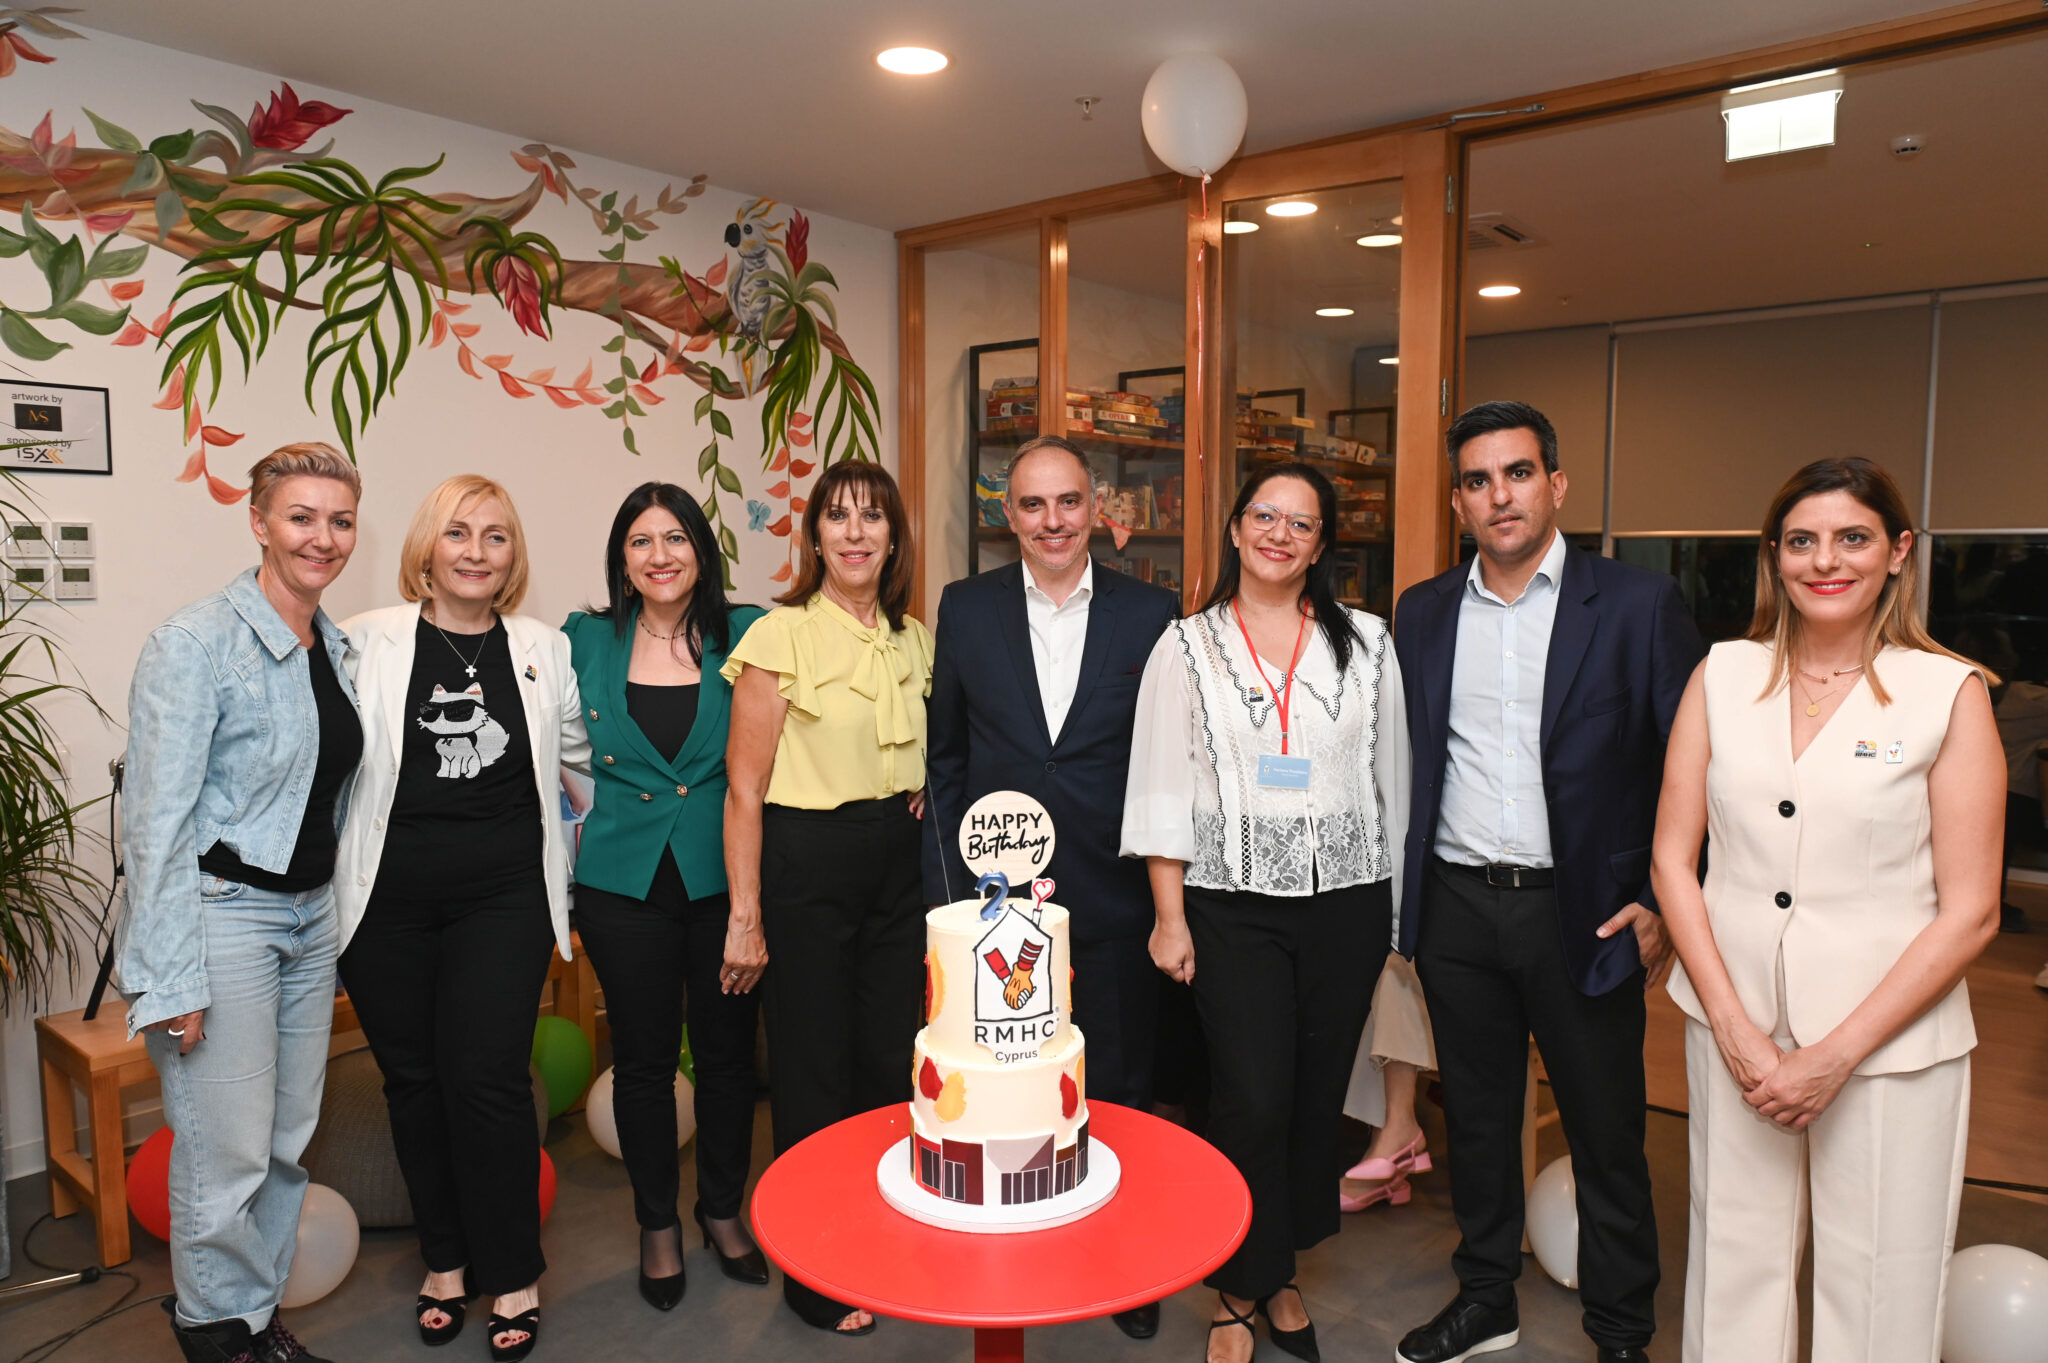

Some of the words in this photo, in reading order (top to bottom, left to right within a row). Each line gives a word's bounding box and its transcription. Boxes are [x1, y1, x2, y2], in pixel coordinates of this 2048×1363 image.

[11, 393, 49, 402] artwork
[52, 395, 63, 404] by
[972, 813, 1043, 830] HAPPY
[967, 828, 1050, 865] Birthday
[974, 1020, 1055, 1043] RMHC
[995, 1050, 1038, 1064] Cyprus
